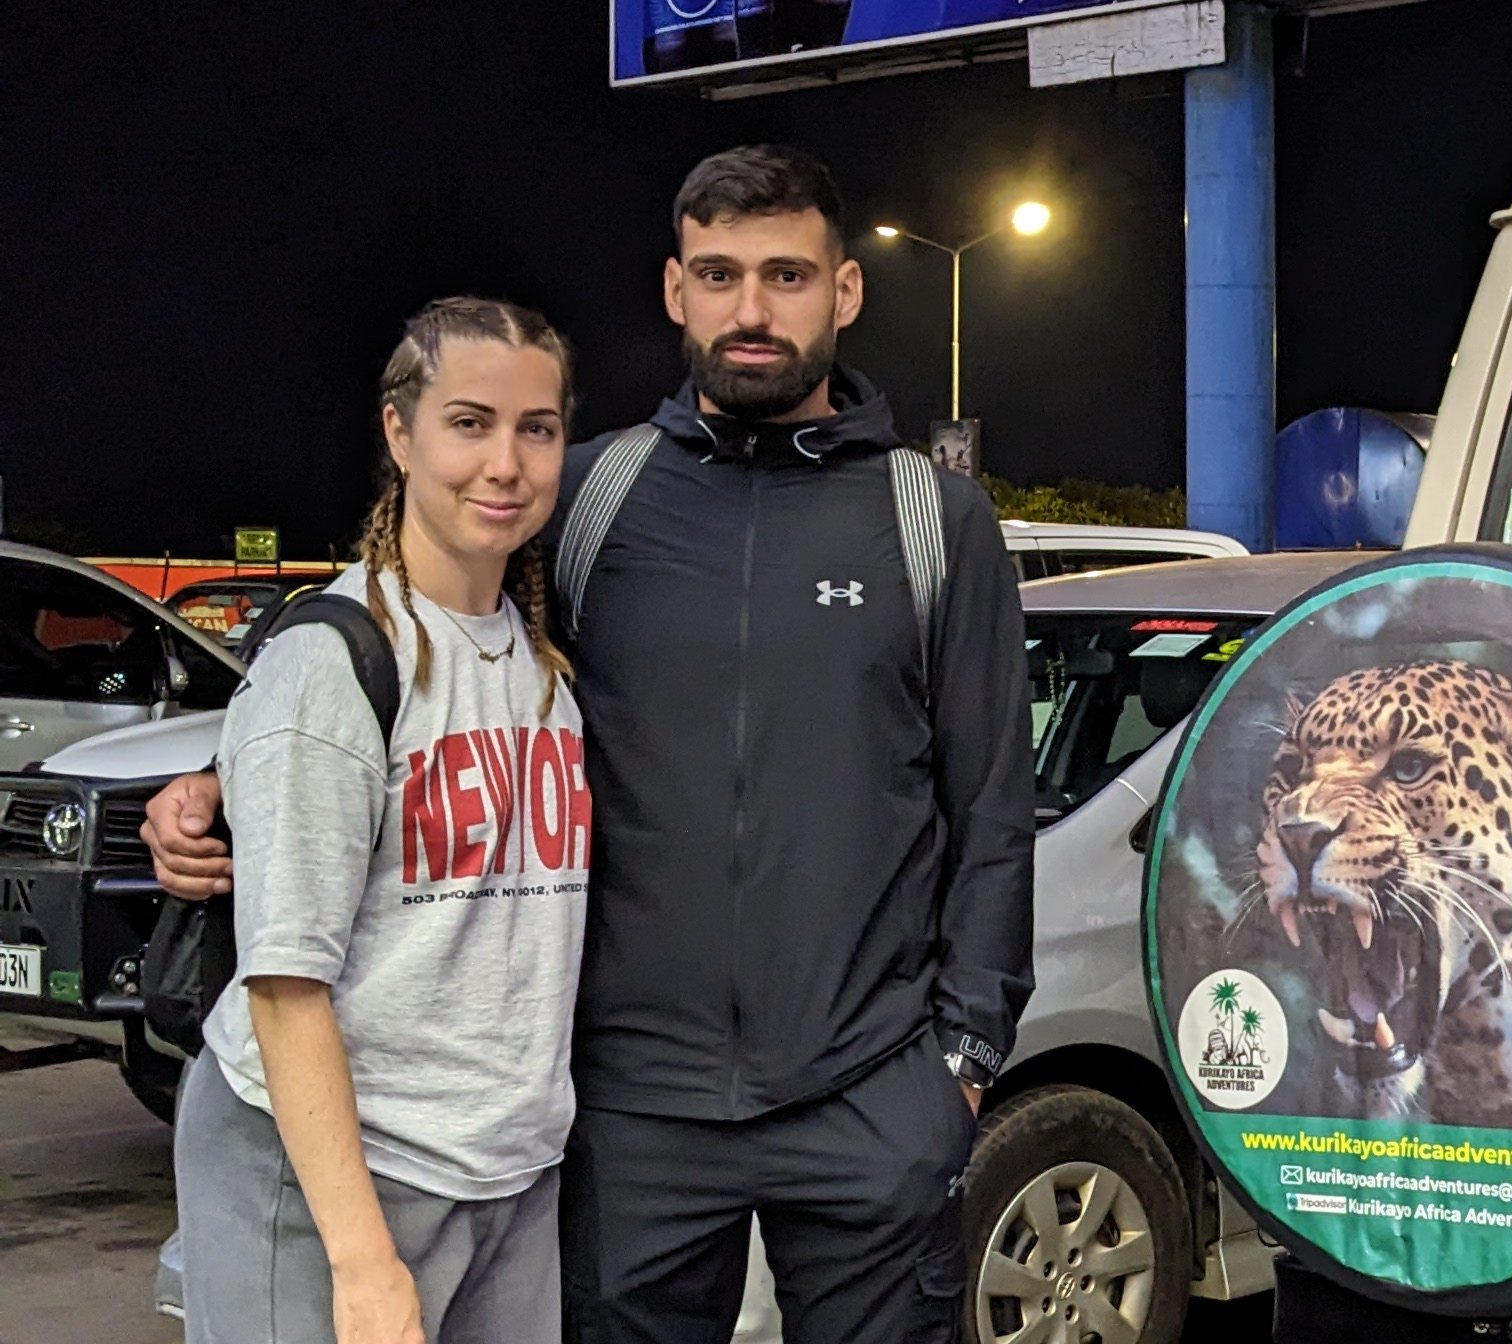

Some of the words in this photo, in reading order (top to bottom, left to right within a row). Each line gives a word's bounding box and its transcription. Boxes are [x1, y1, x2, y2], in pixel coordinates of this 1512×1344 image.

[401, 892, 435, 905] 503
[1237, 1068, 1265, 1081] AFRICA
[1206, 1078, 1255, 1092] ADVENTURES
[1348, 1198, 1412, 1220] Kurikayo
[1414, 1203, 1462, 1224] Africa
